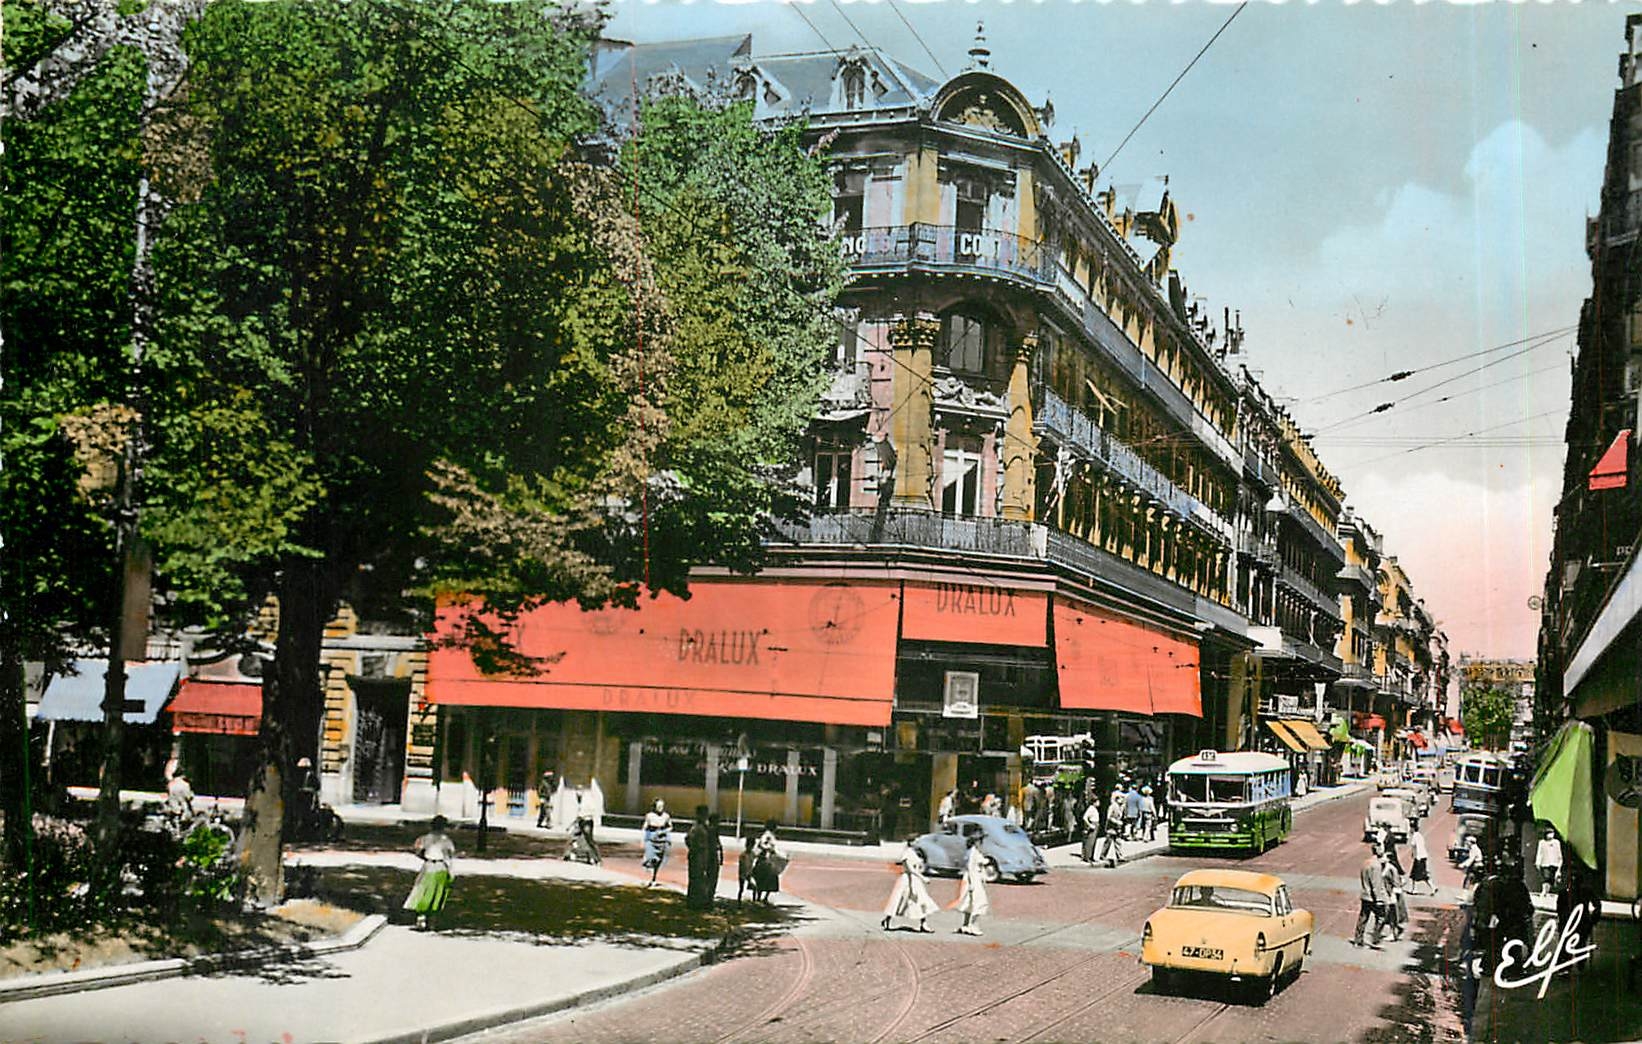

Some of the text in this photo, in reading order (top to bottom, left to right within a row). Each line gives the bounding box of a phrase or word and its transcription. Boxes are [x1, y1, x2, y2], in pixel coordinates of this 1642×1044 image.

[936, 583, 1016, 616] DRALUX
[678, 628, 761, 666] DRALUX
[756, 762, 818, 777] DRALUX
